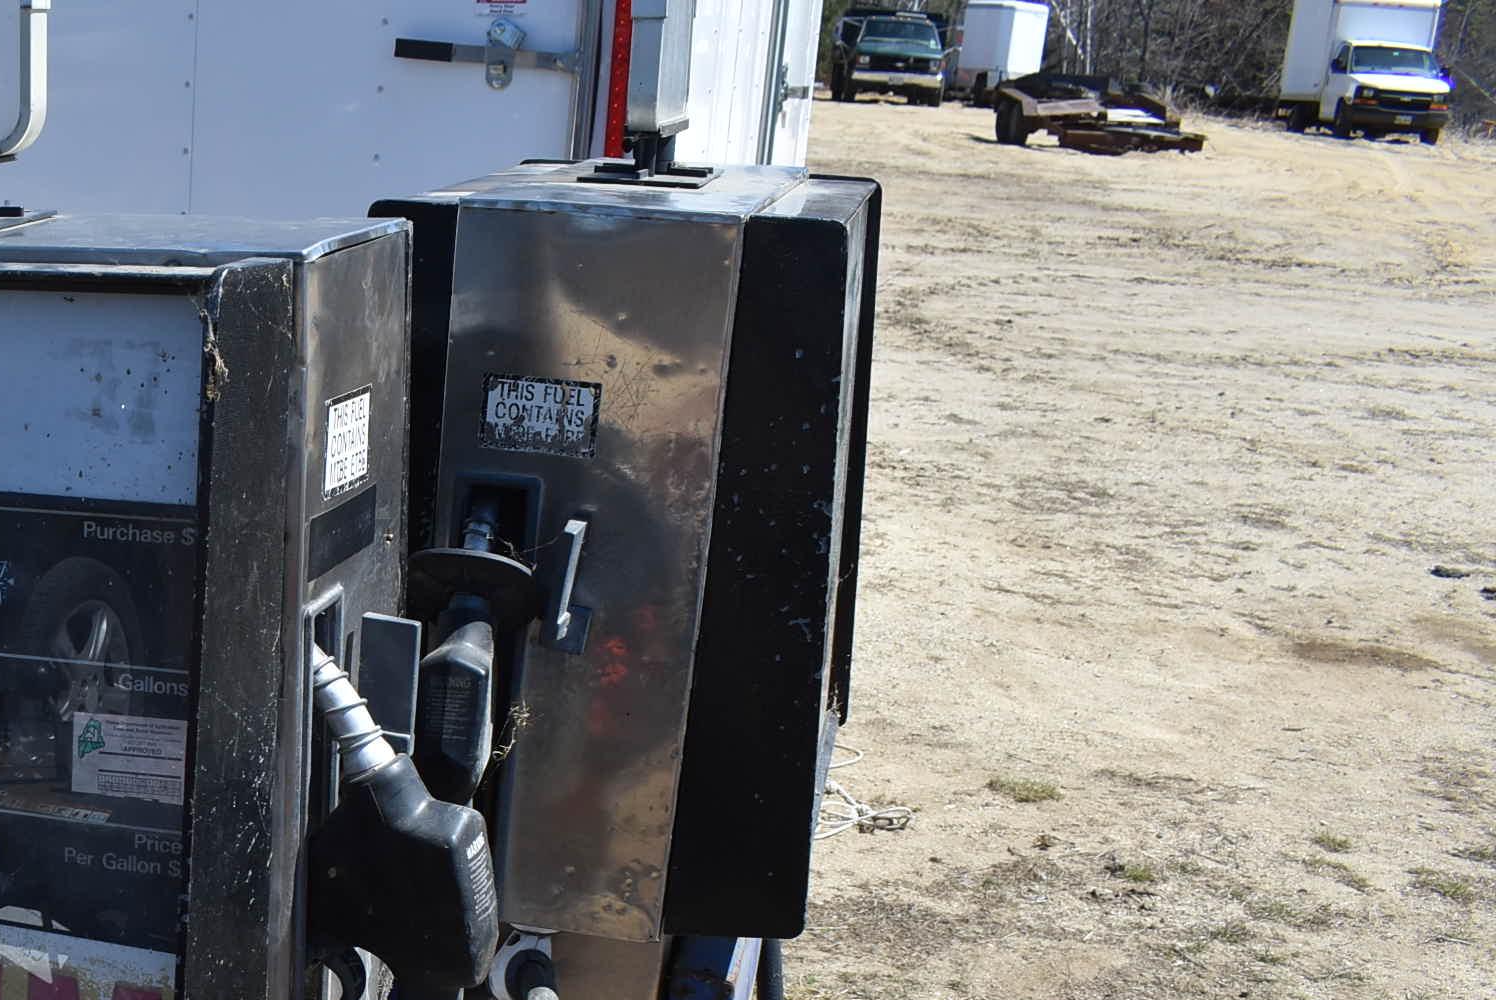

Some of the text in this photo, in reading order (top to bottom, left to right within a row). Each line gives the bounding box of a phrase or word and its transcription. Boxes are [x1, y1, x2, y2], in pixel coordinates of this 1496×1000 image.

[497, 381, 585, 406] THIS FUEL
[334, 404, 348, 430] THIS
[495, 401, 585, 427] CONTAINS
[331, 423, 366, 458] CONTAINS
[83, 521, 196, 546] Purchase $
[118, 673, 189, 697] Gallons
[134, 833, 183, 855] Price
[64, 847, 94, 865] Per
[102, 852, 161, 873] Gallon
